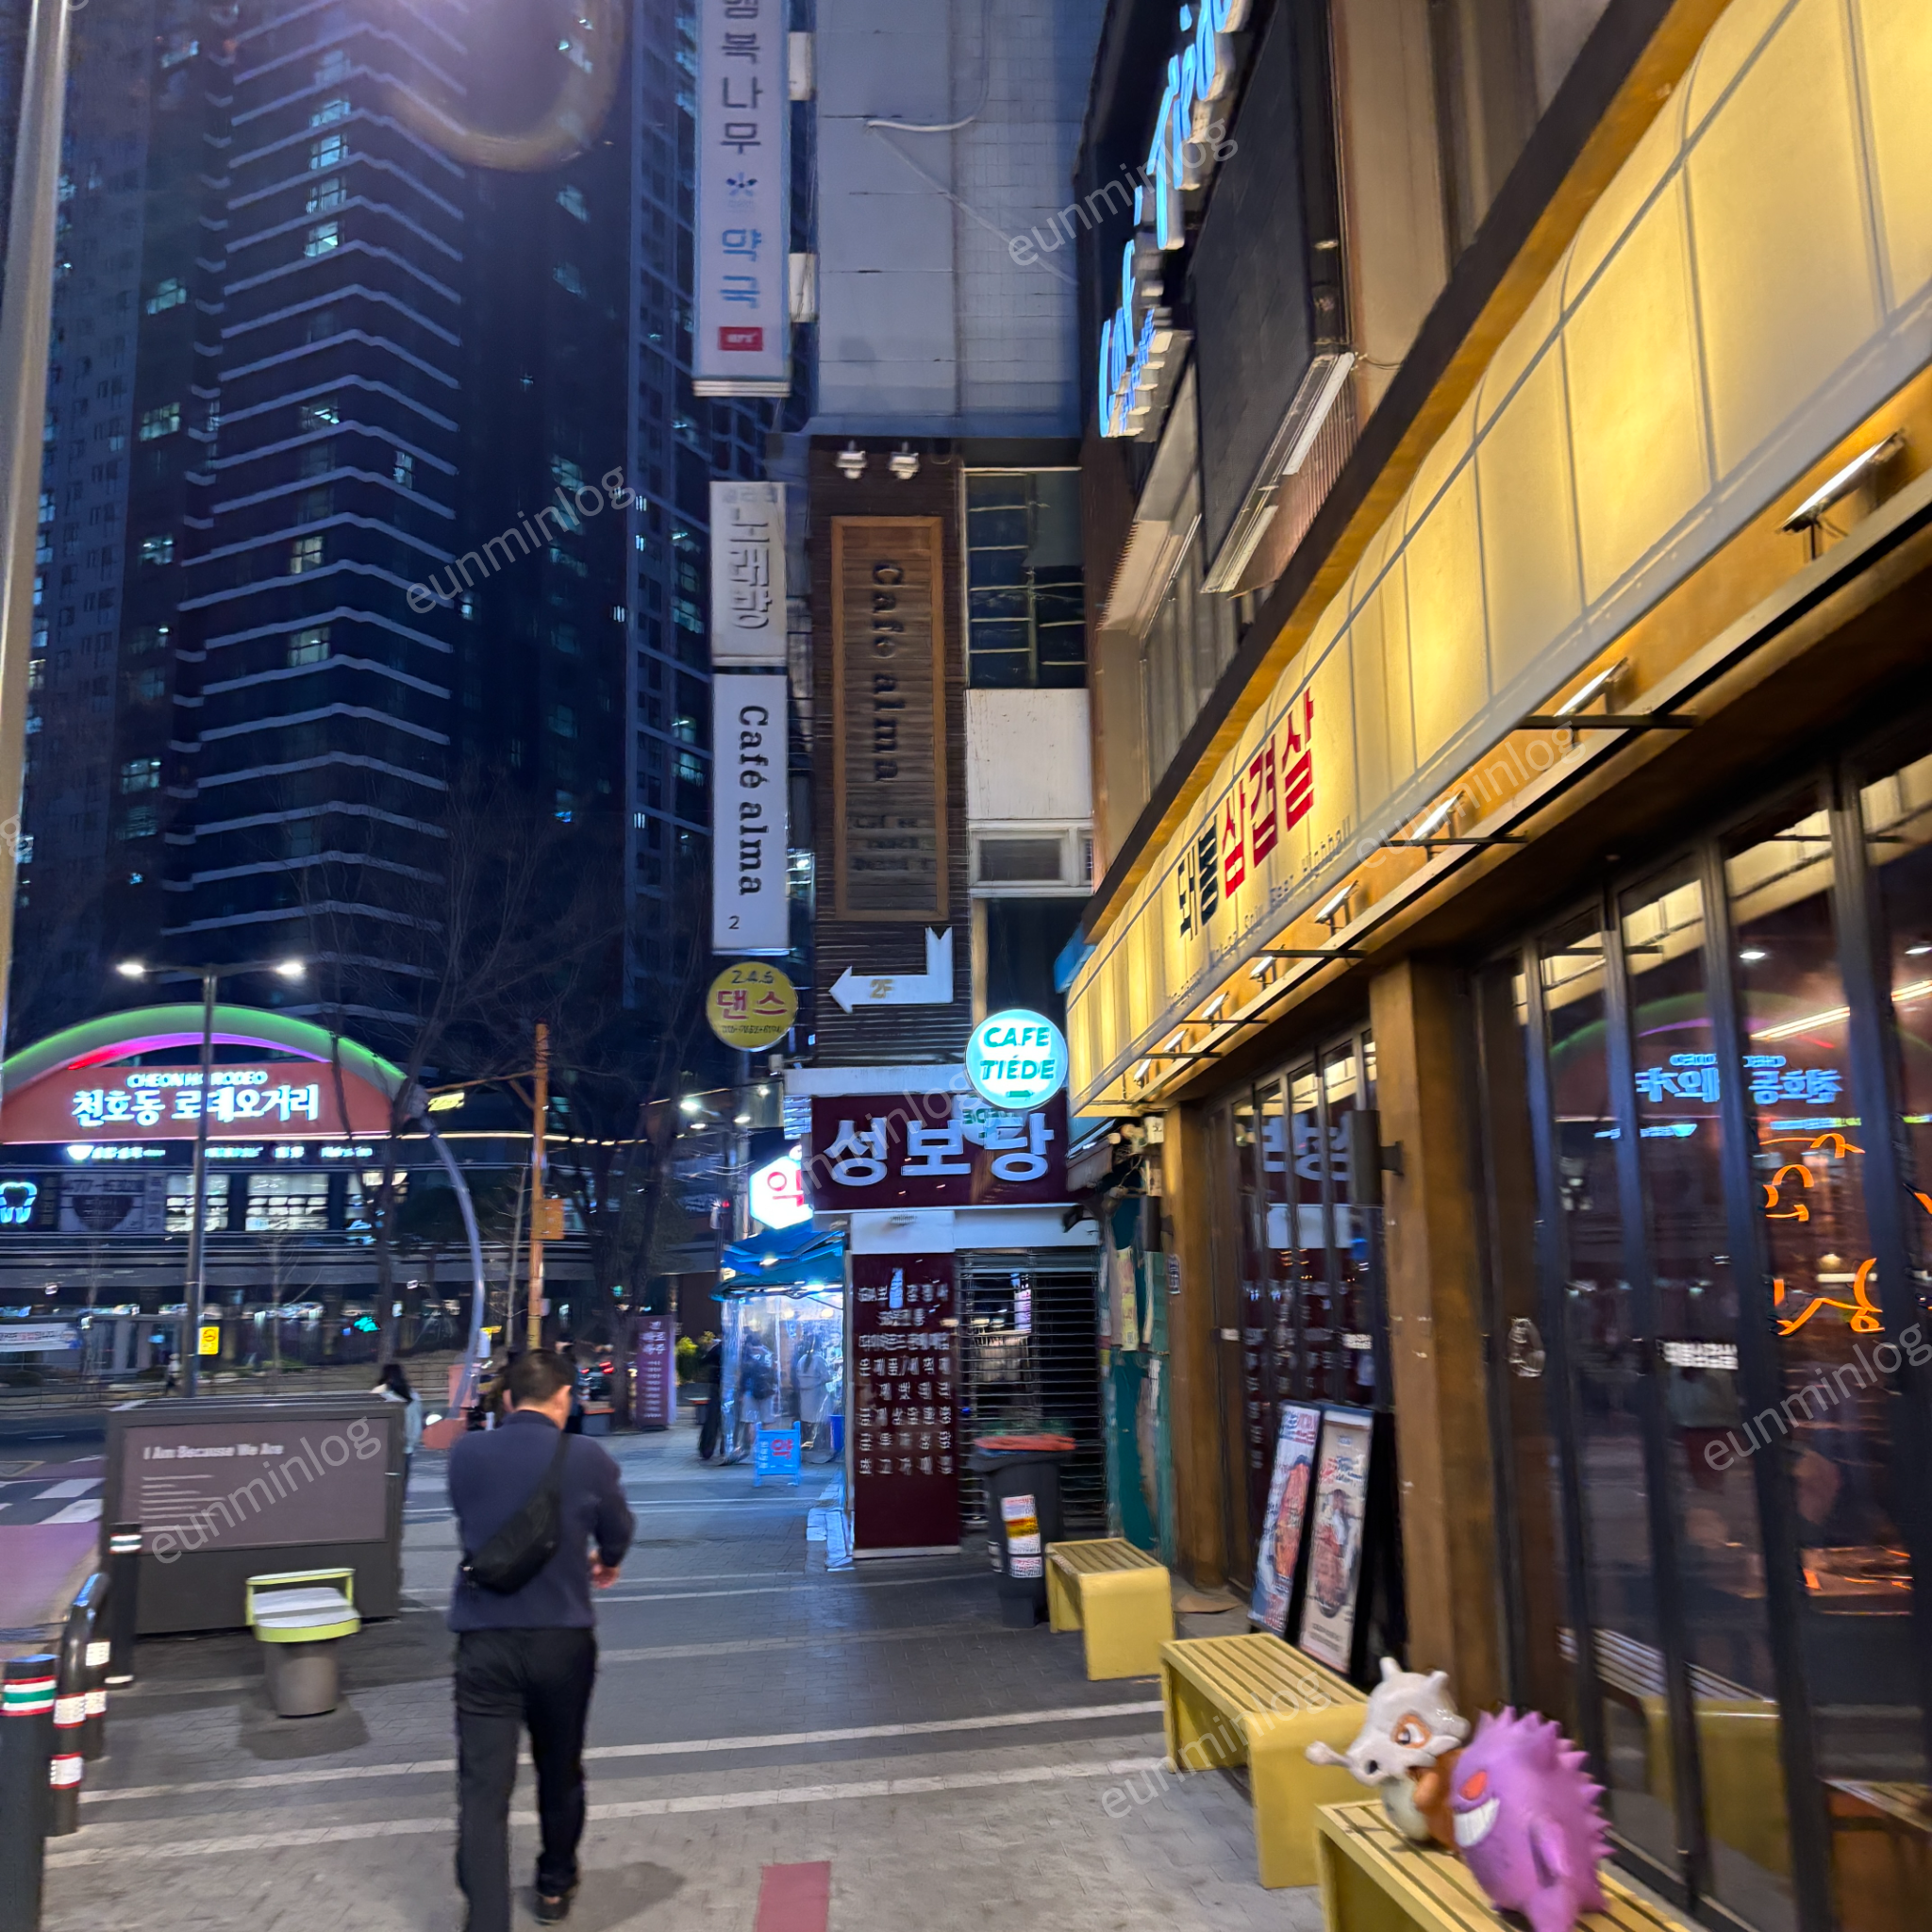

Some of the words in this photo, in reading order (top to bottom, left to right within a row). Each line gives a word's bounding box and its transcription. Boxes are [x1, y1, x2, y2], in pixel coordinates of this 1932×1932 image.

[873, 672, 907, 782] alma
[738, 705, 770, 789] Café
[738, 801, 770, 896] alma
[728, 915, 741, 930] 2
[869, 978, 895, 999] 2F
[717, 990, 788, 1020] 댄스
[983, 1026, 1050, 1048] CAFE
[210, 1071, 269, 1087] RODEO
[72, 1089, 166, 1127] 천호동
[824, 1112, 1055, 1187] 성보당
[152, 1445, 176, 1459] Am
[176, 1444, 236, 1457] Because
[236, 1443, 258, 1457] We
[259, 1442, 284, 1455] Are
